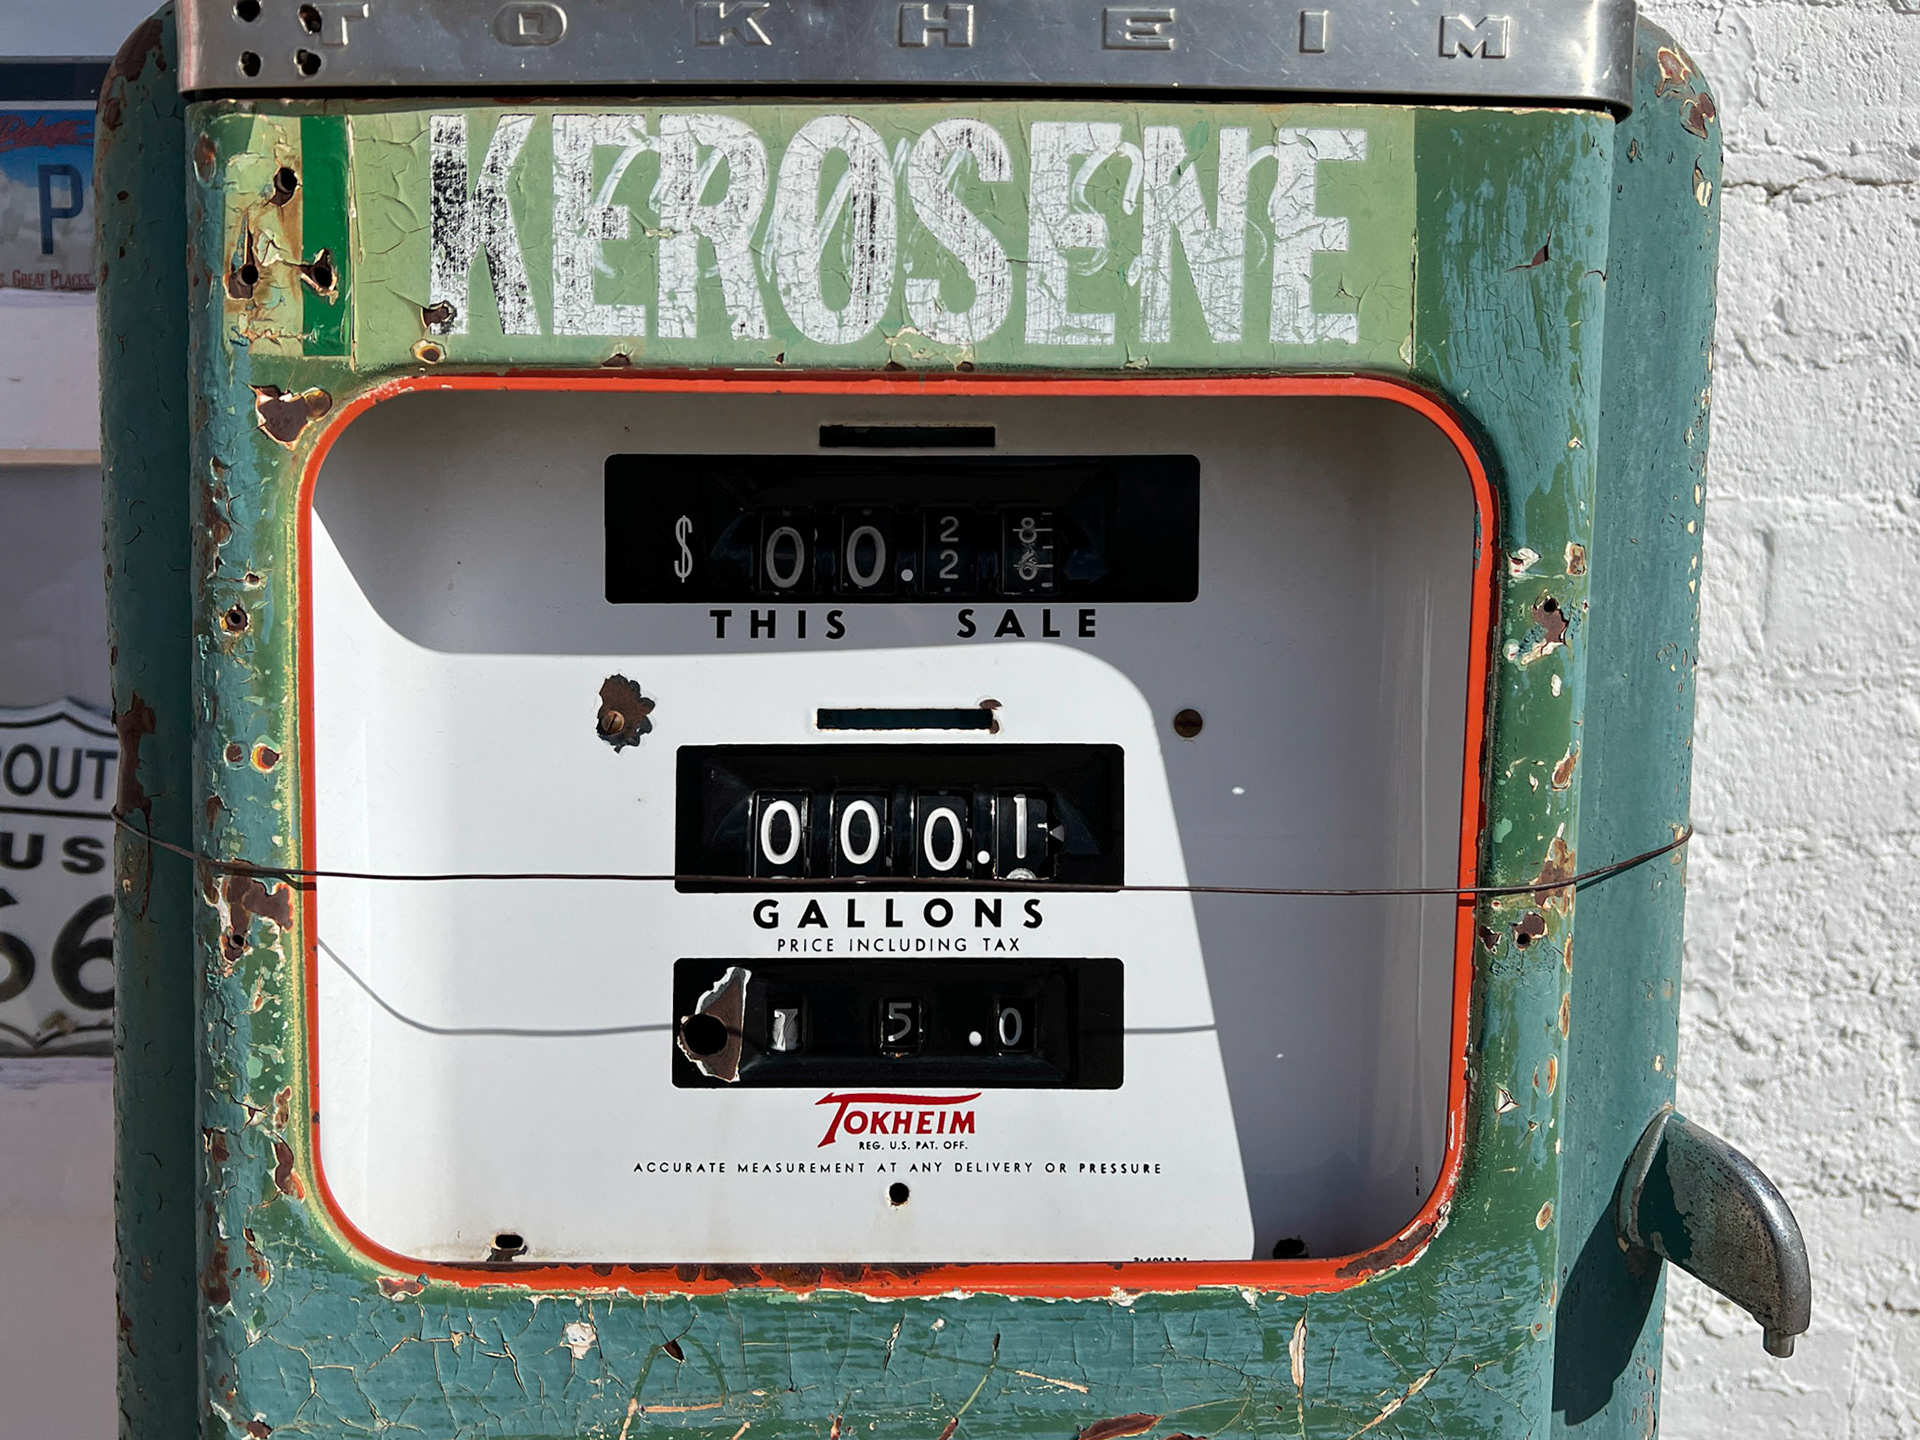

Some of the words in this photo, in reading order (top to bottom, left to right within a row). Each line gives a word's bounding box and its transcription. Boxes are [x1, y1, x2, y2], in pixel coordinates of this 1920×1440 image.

[300, 2, 1508, 58] TOKHEIM
[37, 163, 84, 254] P
[429, 114, 1368, 347] KEROSENE
[709, 609, 846, 640] THIS
[956, 608, 1096, 639] SALE
[0, 742, 118, 800] OUT
[0, 831, 105, 875] US
[752, 897, 1043, 930] GALLONS
[777, 937, 834, 953] PRICE
[849, 937, 967, 952] INCLUDING
[982, 937, 1020, 952] TAX
[815, 1092, 982, 1148] TOKHEIM
[858, 1140, 885, 1151] REG.
[889, 1140, 911, 1150] U.S.
[915, 1140, 939, 1150] PAT.
[943, 1140, 968, 1150] OFF.
[633, 1161, 726, 1174] ACCURATE
[737, 1161, 865, 1174] MEASUREMENT
[876, 1162, 897, 1173] AT
[909, 1161, 942, 1173] ANY
[954, 1161, 1033, 1173] DELIVERY
[1044, 1162, 1067, 1174] OR
[1079, 1162, 1162, 1175] PRESSURE
